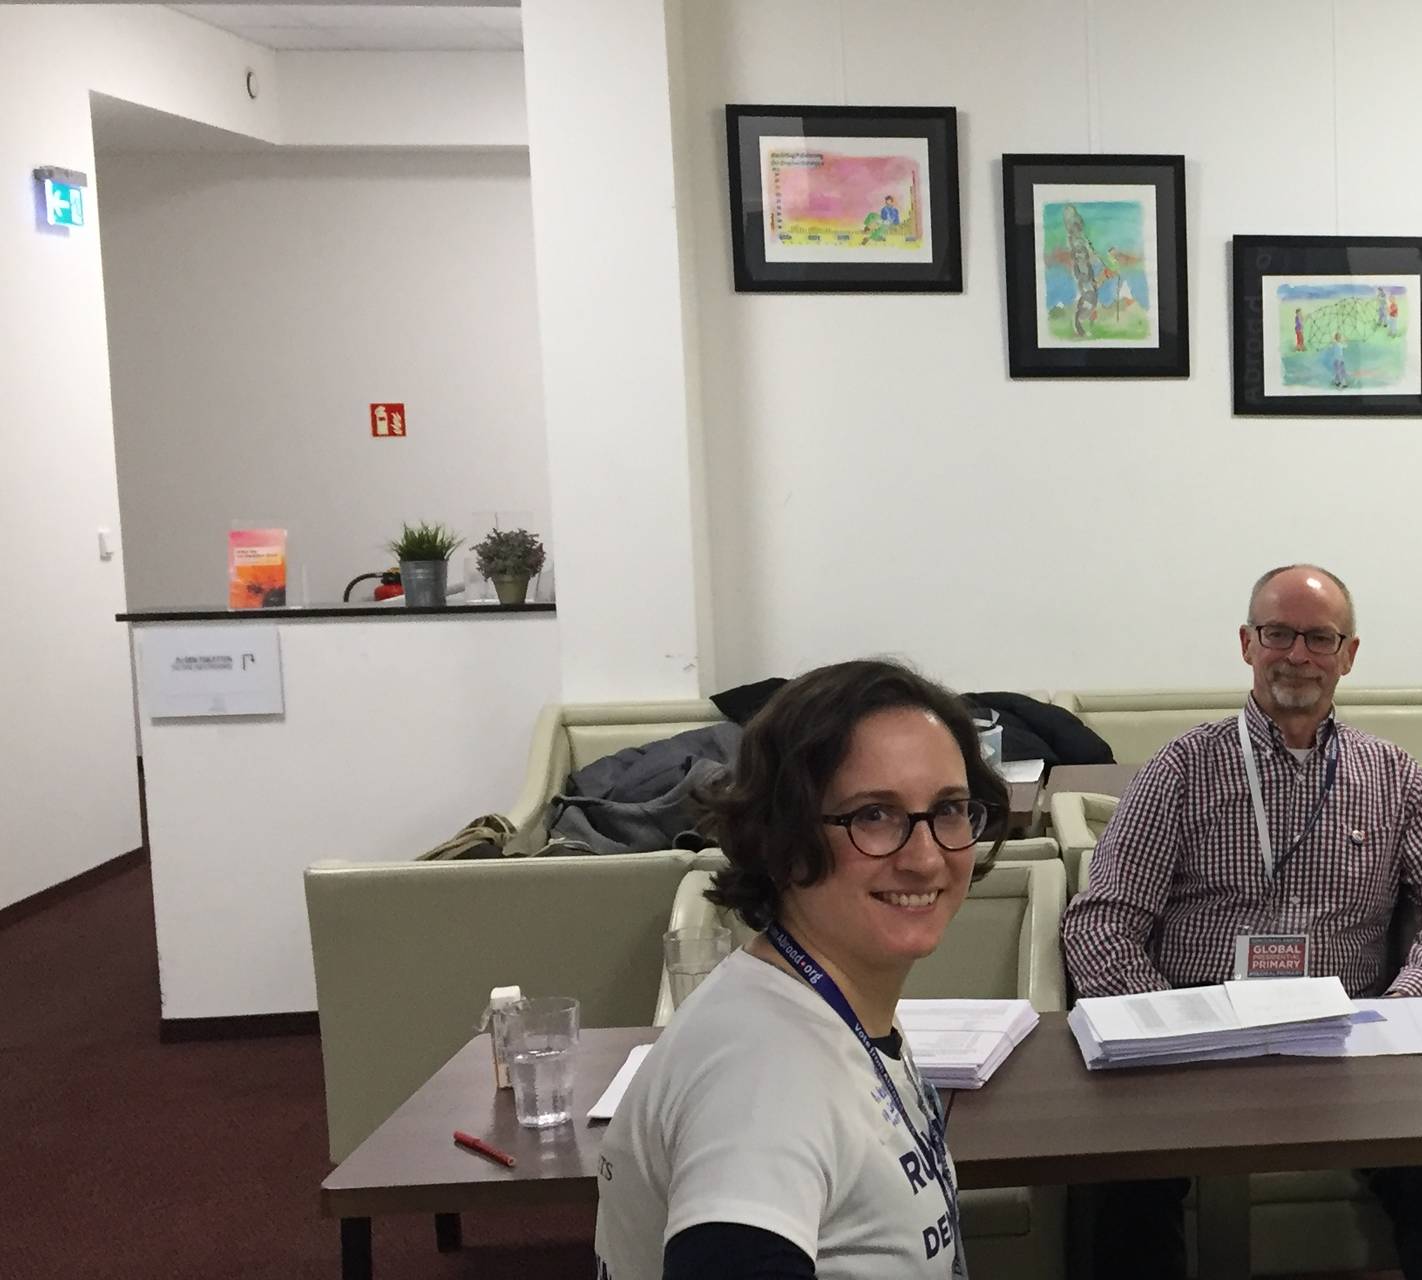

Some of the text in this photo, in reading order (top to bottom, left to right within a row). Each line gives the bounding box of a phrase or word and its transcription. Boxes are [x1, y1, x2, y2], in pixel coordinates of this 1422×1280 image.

[1253, 944, 1301, 954] GLOBAL
[1252, 959, 1301, 969] PRIMARY
[922, 1212, 954, 1260] DE
